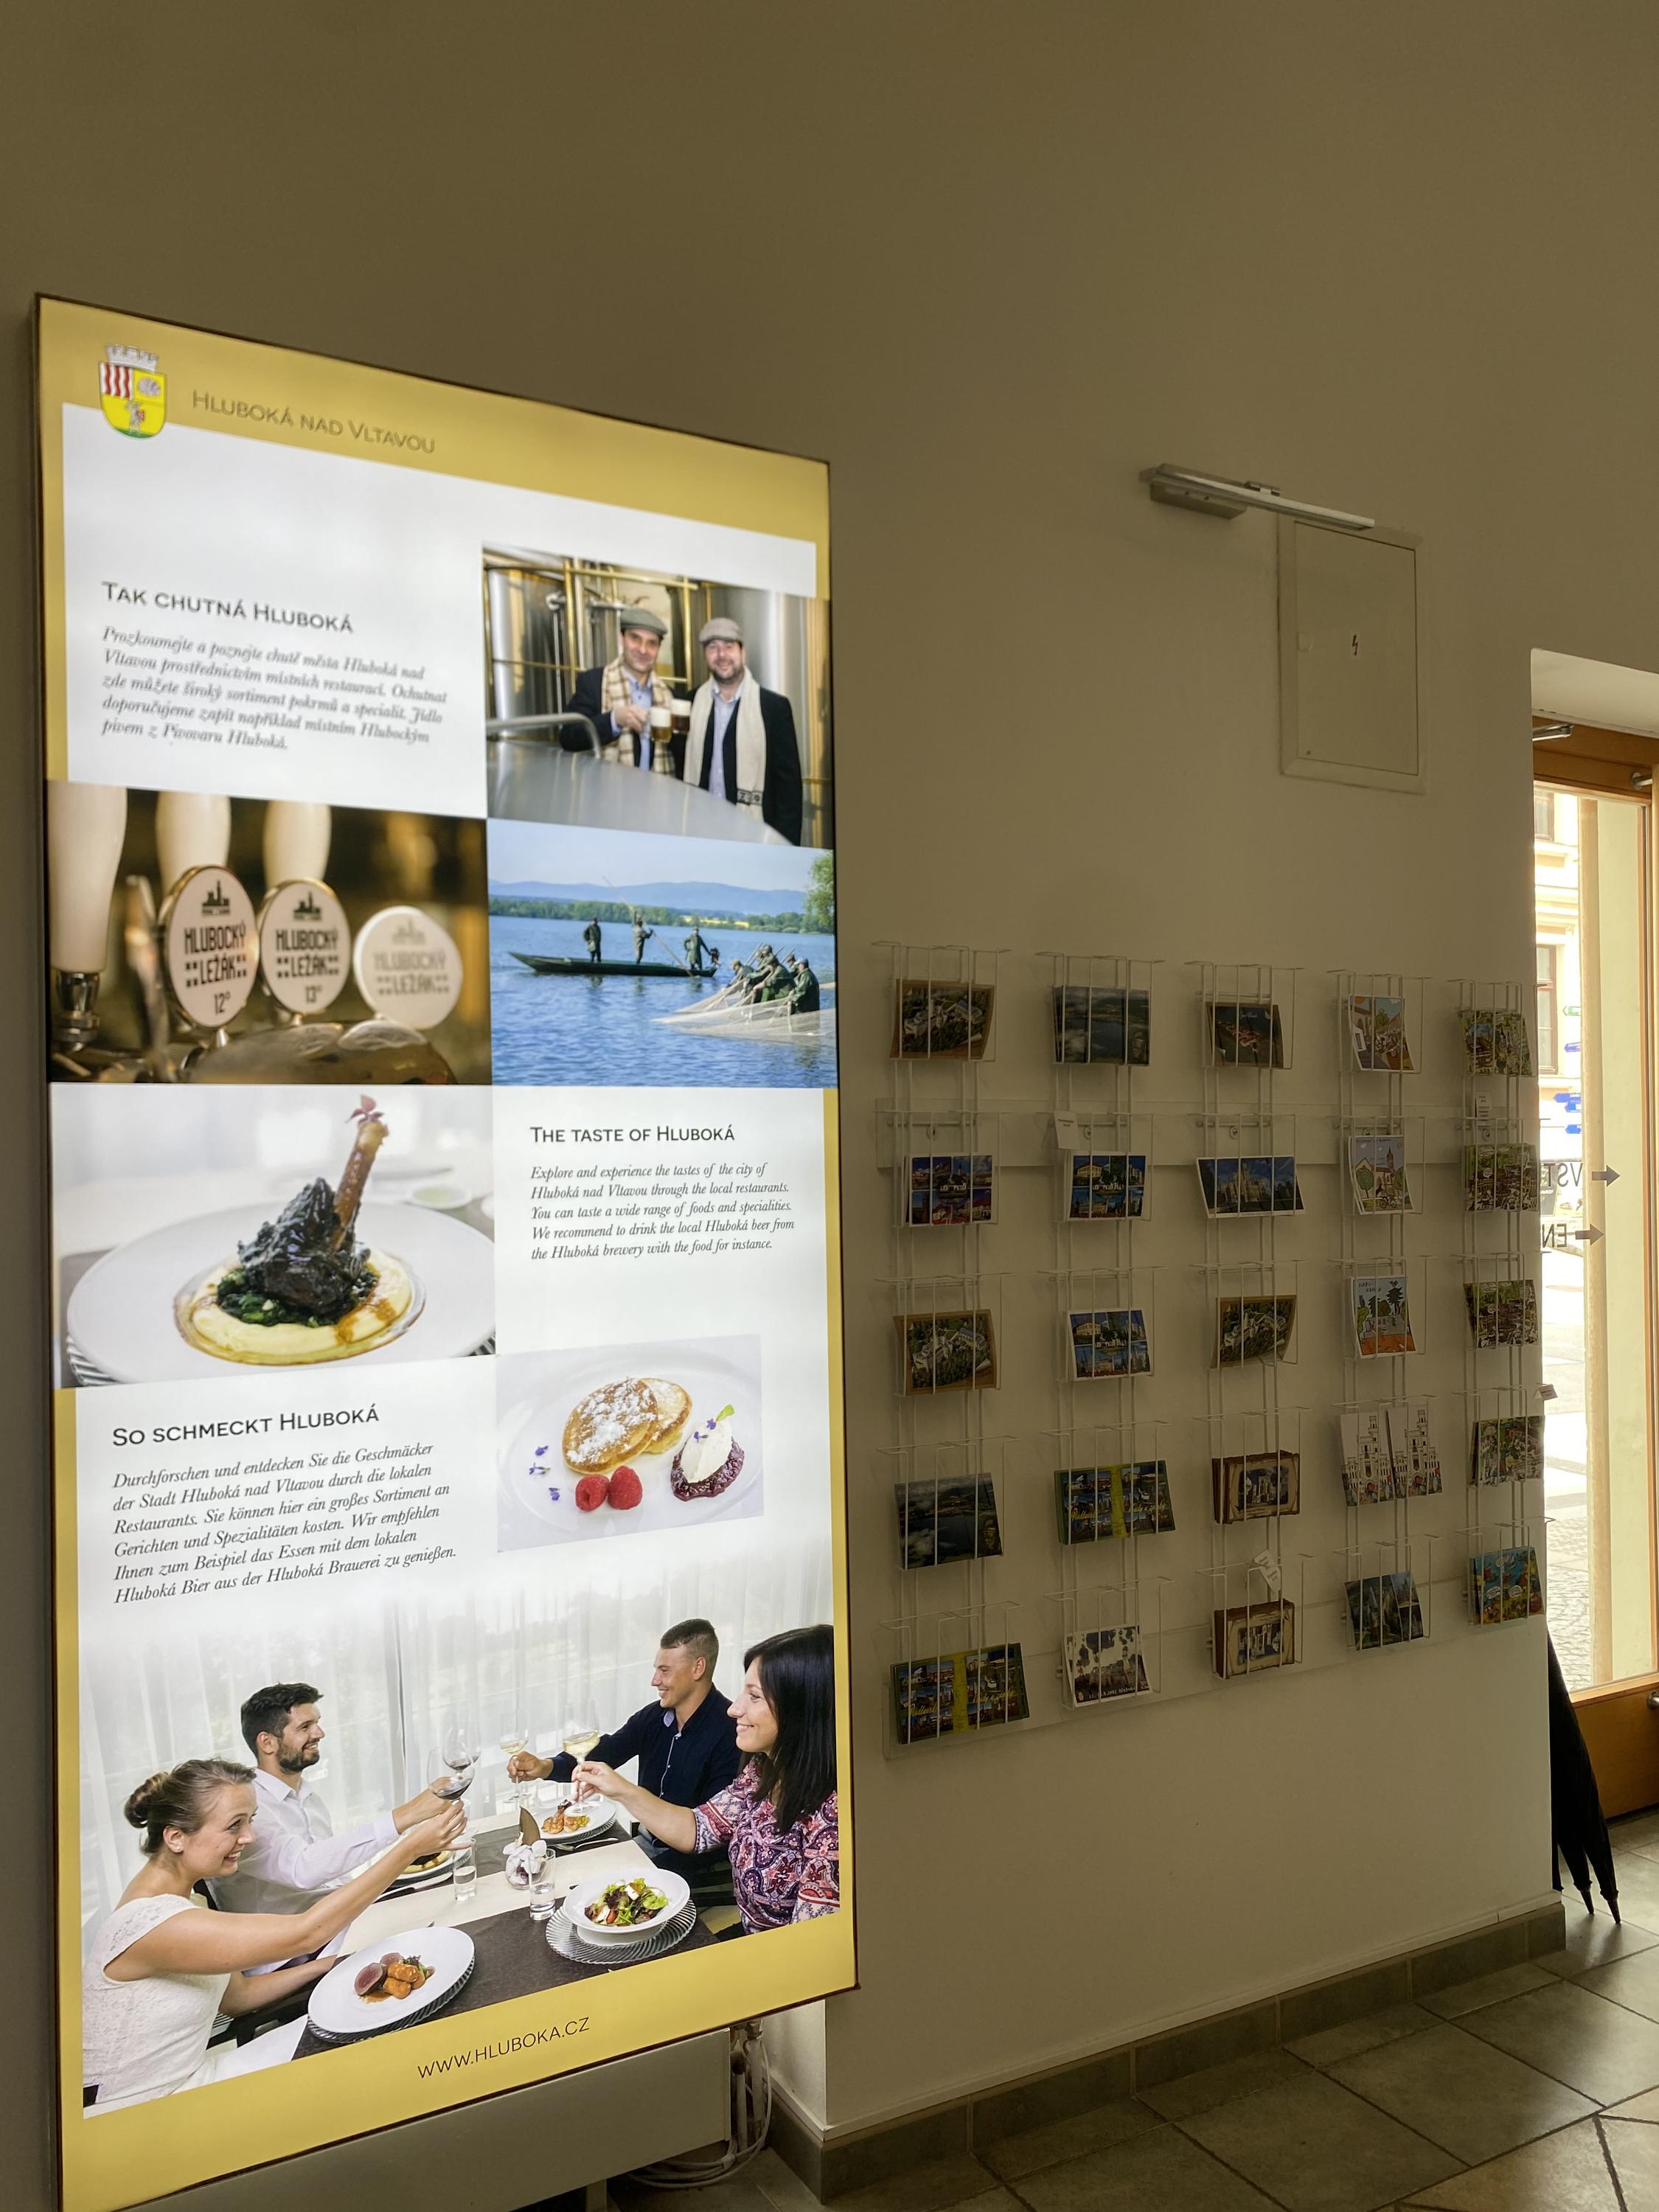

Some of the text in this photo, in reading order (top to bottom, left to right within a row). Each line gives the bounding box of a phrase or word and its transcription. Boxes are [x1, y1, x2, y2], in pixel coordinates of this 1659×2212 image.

[102, 625, 194, 655] Prozkoumejte
[196, 643, 206, 654] a
[209, 643, 263, 663] poznejte
[302, 654, 339, 670] města
[343, 656, 397, 677] Hluboká
[400, 667, 425, 681] nad
[105, 648, 157, 670] Vltavou
[159, 658, 262, 682] prostřednictvím
[265, 671, 320, 689] místních
[102, 672, 127, 689] zde
[131, 676, 180, 695] můžete
[226, 688, 286, 706] sortiment
[288, 695, 338, 712] pokrmů
[341, 703, 350, 714] a
[101, 717, 144, 737] pivem
[148, 726, 157, 739] z
[162, 723, 223, 743] Pivovaru
[102, 694, 195, 720] doporučujeme
[237, 712, 302, 730] například
[305, 719, 356, 735] místním
[360, 722, 429, 744] Hlubockým
[184, 921, 246, 955] HLUBOCKÝ
[276, 926, 338, 952] HLUBOCKÝ
[199, 956, 236, 987] LEŽÁK
[530, 1161, 768, 1183] Explore and experience the tastes of the city of
[530, 1181, 789, 1200] Hluboká nad Vltavou through the local restaurants.
[531, 1198, 792, 1220] You can taste a wide range of foods and specialities.
[532, 1217, 795, 1240] We recommend to drink the local Hluboká beer from
[531, 1237, 773, 1260] the Hluboká brewery with the food for instance.
[111, 1441, 434, 1489] Durchforschen und entdecken Sie die Geschmäcker
[112, 1463, 432, 1512] der Stadt Hluboká nad Vltavou durch die lokalen
[112, 1485, 450, 1535] Restaurants. Sie können hier ein großes Sortiment an
[114, 1504, 440, 1558] Gerichten und Spezialitäten kosten. Wir empfehlen
[113, 1528, 417, 1581] Ihnen zum Beispiel das Essen mit dem lokalen
[113, 1545, 456, 1604] Hluboká Bier aus der Hluboká Brauerei zu genießen.
[417, 2017, 590, 2079] WWW.HLUBOKA.CZ
